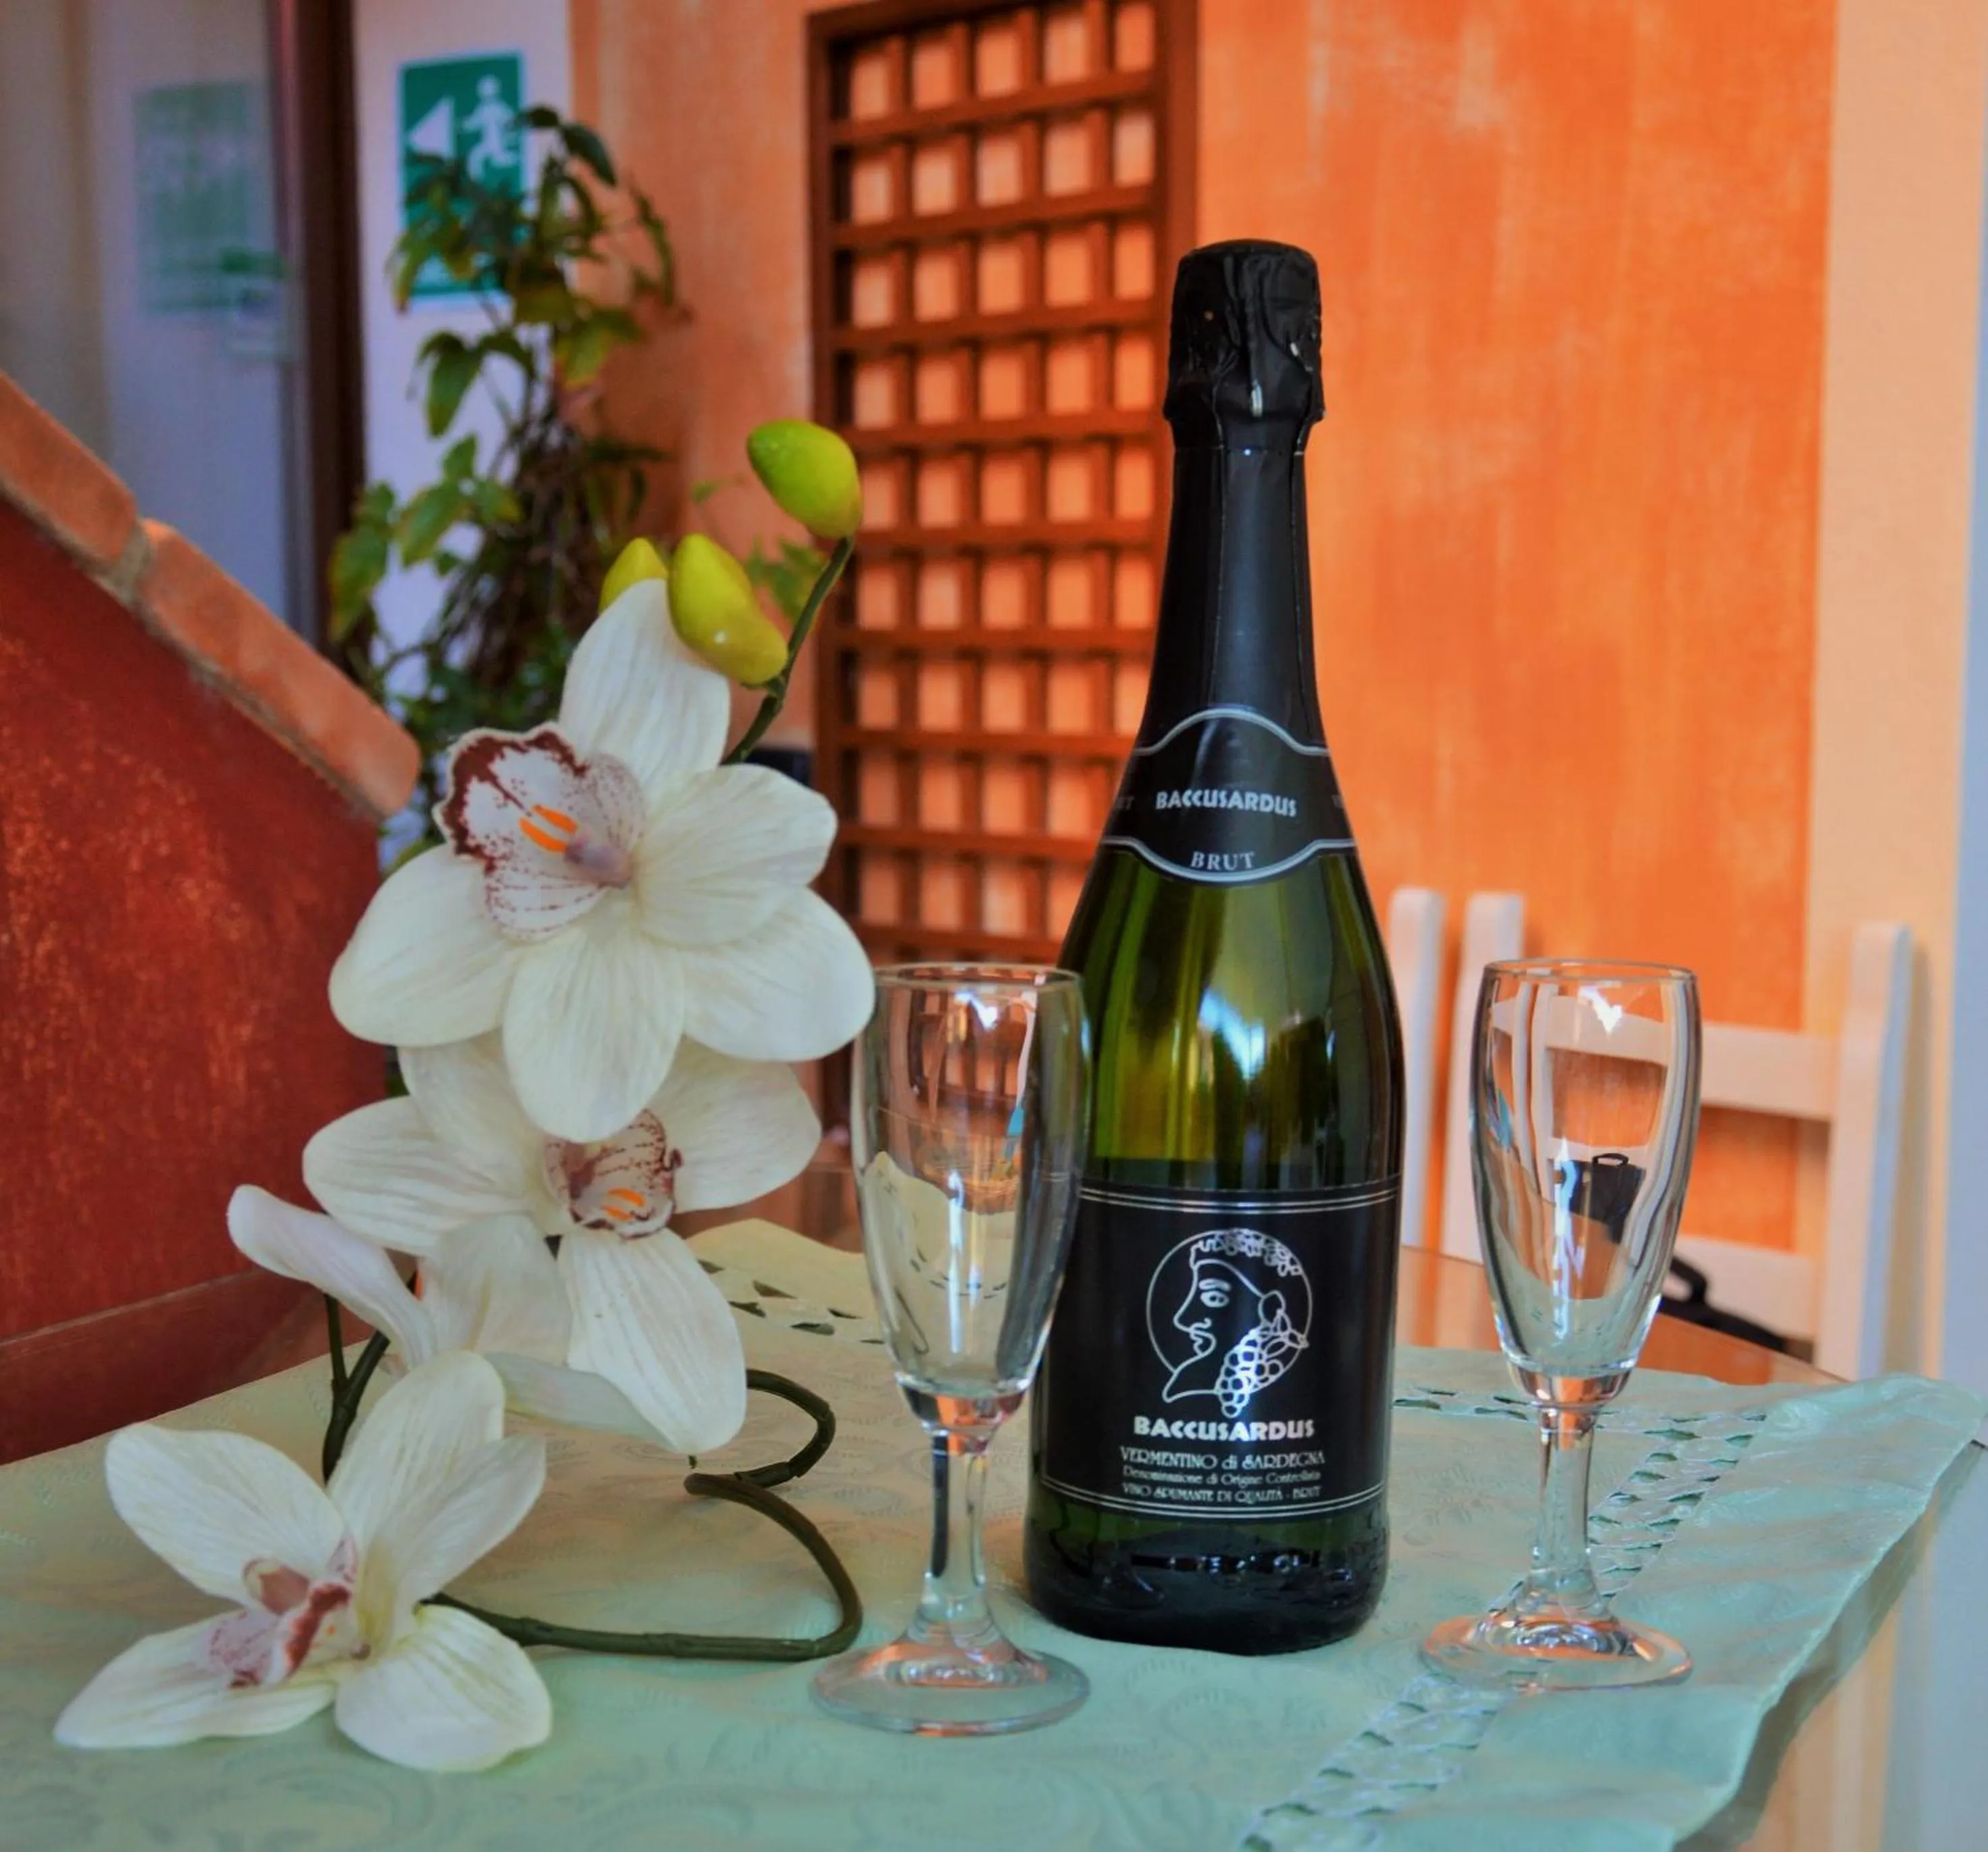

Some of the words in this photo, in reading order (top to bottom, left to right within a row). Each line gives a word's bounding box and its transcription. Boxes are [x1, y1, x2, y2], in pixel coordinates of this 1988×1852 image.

[1156, 789, 1296, 817] BACCUSARDUS
[1190, 851, 1255, 871] BRUT
[1134, 1415, 1315, 1441] BACCUSARDUS
[1120, 1445, 1218, 1469] VERMENTINO
[1222, 1454, 1238, 1469] di
[1241, 1450, 1325, 1469] SARDEGNA
